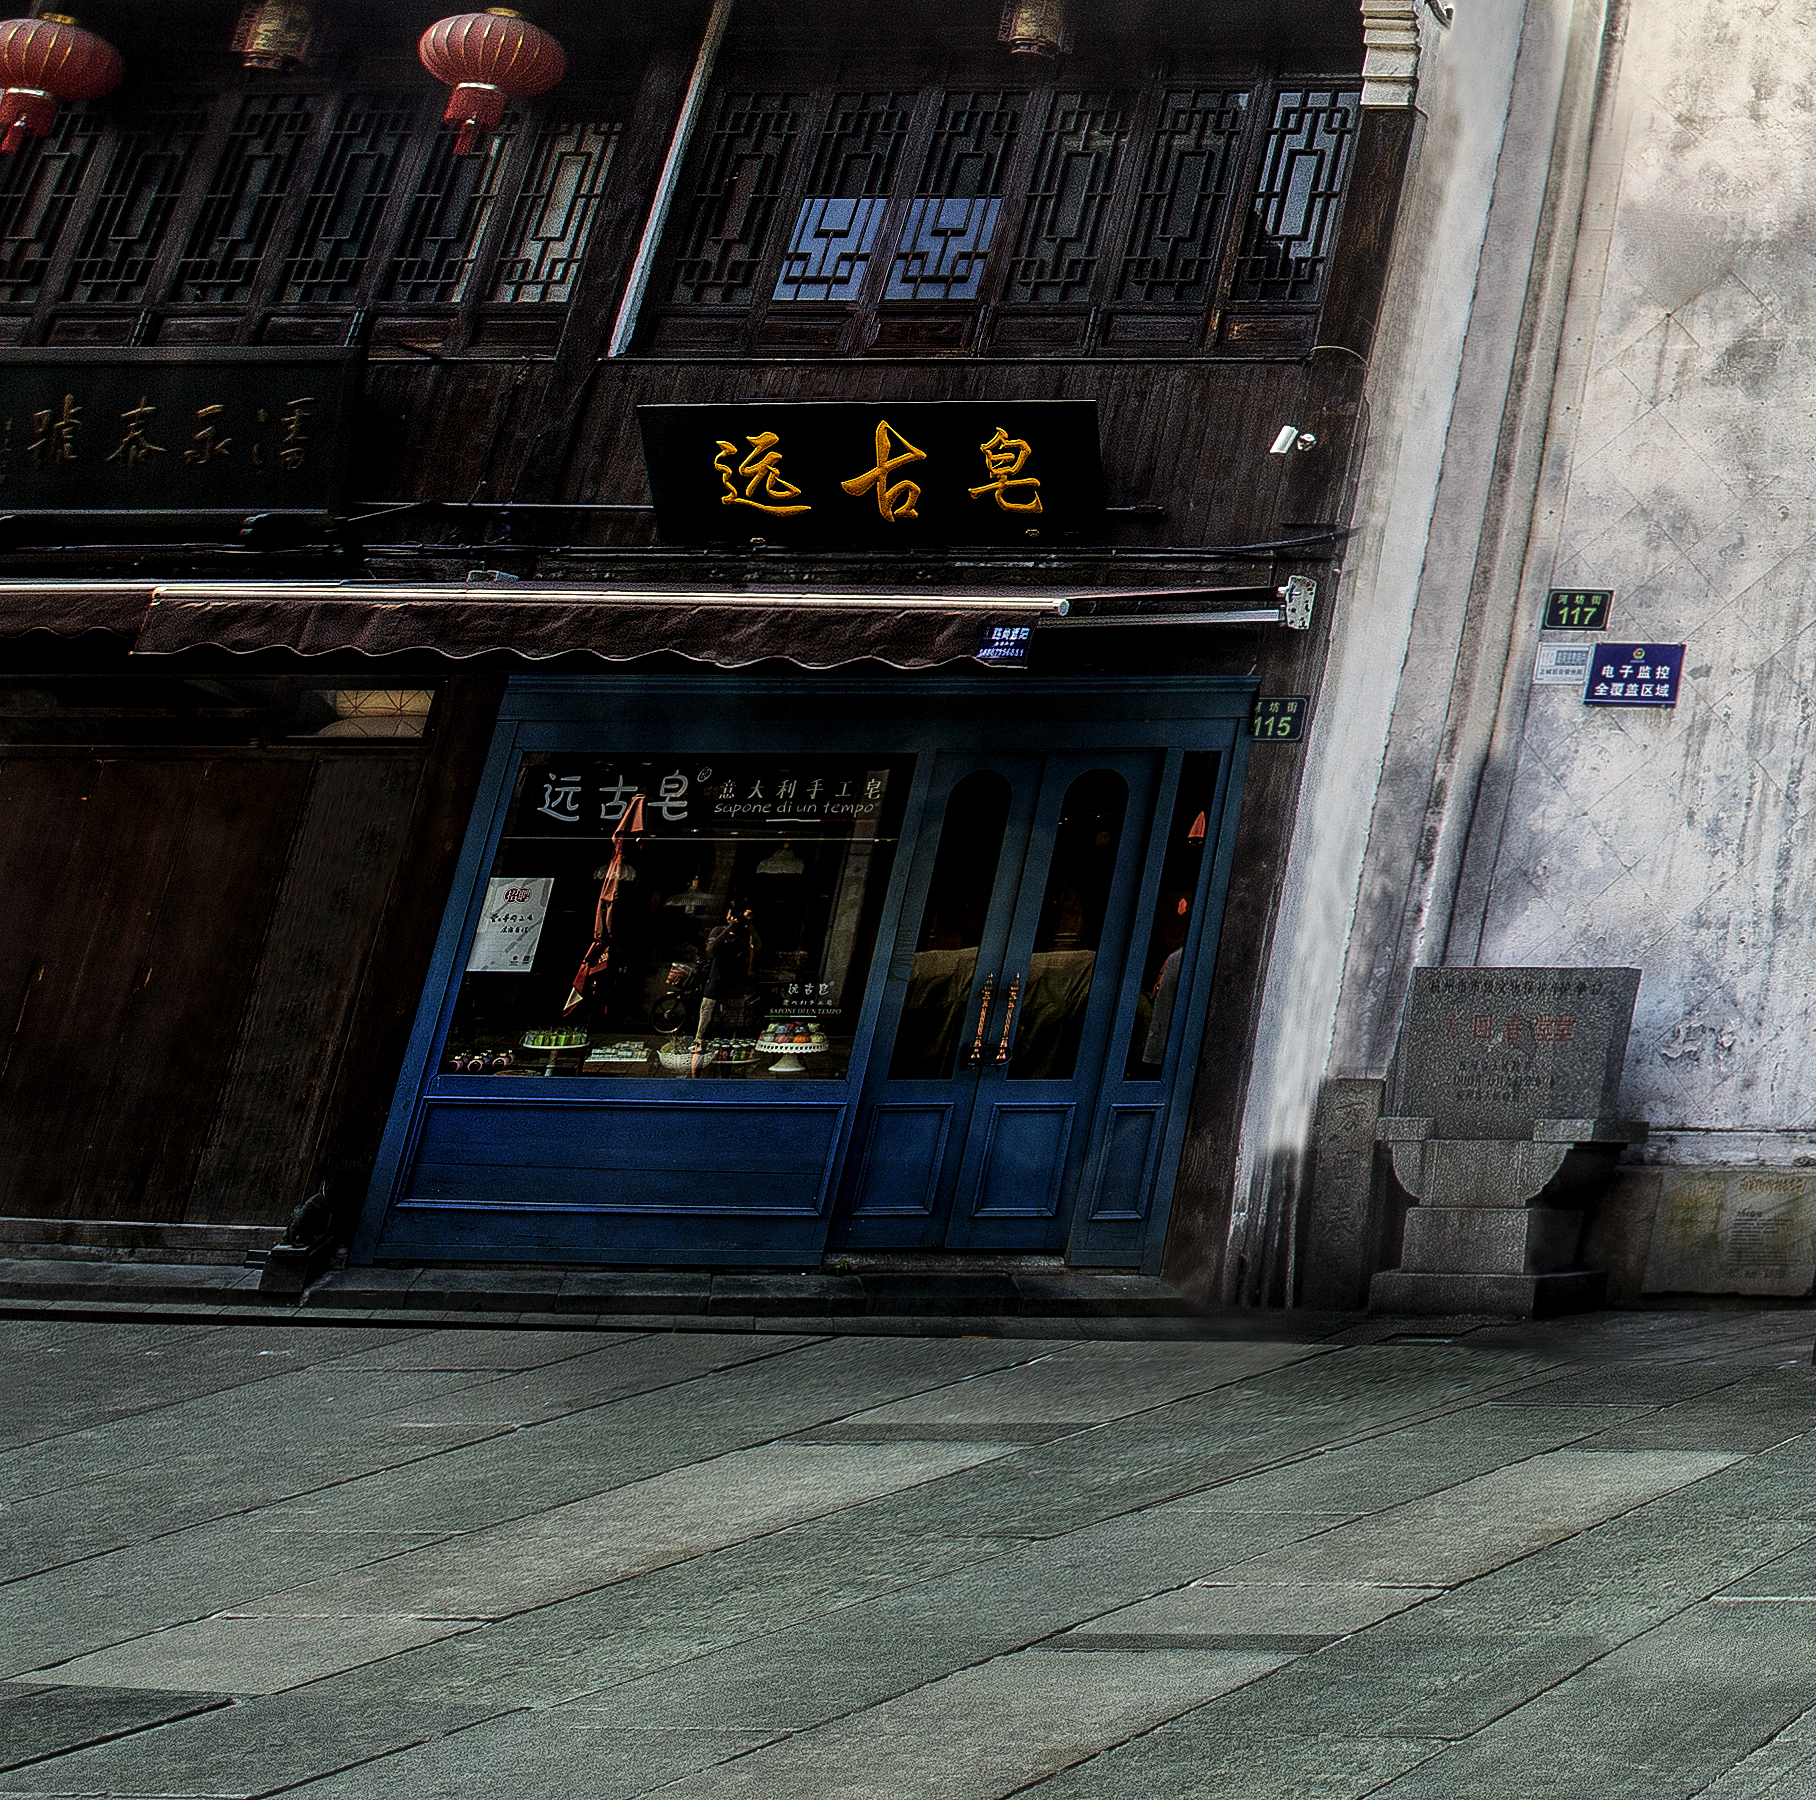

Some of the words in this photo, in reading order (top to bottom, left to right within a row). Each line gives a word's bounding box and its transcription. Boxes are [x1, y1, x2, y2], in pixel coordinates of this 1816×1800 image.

[714, 420, 1043, 522] 远古皂
[1557, 594, 1602, 605] 河坊街
[1558, 606, 1597, 625] 117
[1601, 664, 1670, 679] 电子监控
[1594, 683, 1669, 697] 全覆盖区域
[1254, 716, 1291, 736] 115
[536, 769, 688, 822] 远古皂
[719, 779, 882, 800] 意大利手工皂
[714, 802, 774, 815] sapone
[776, 800, 791, 813] di
[796, 803, 817, 813] un
[824, 800, 874, 815] tempo
